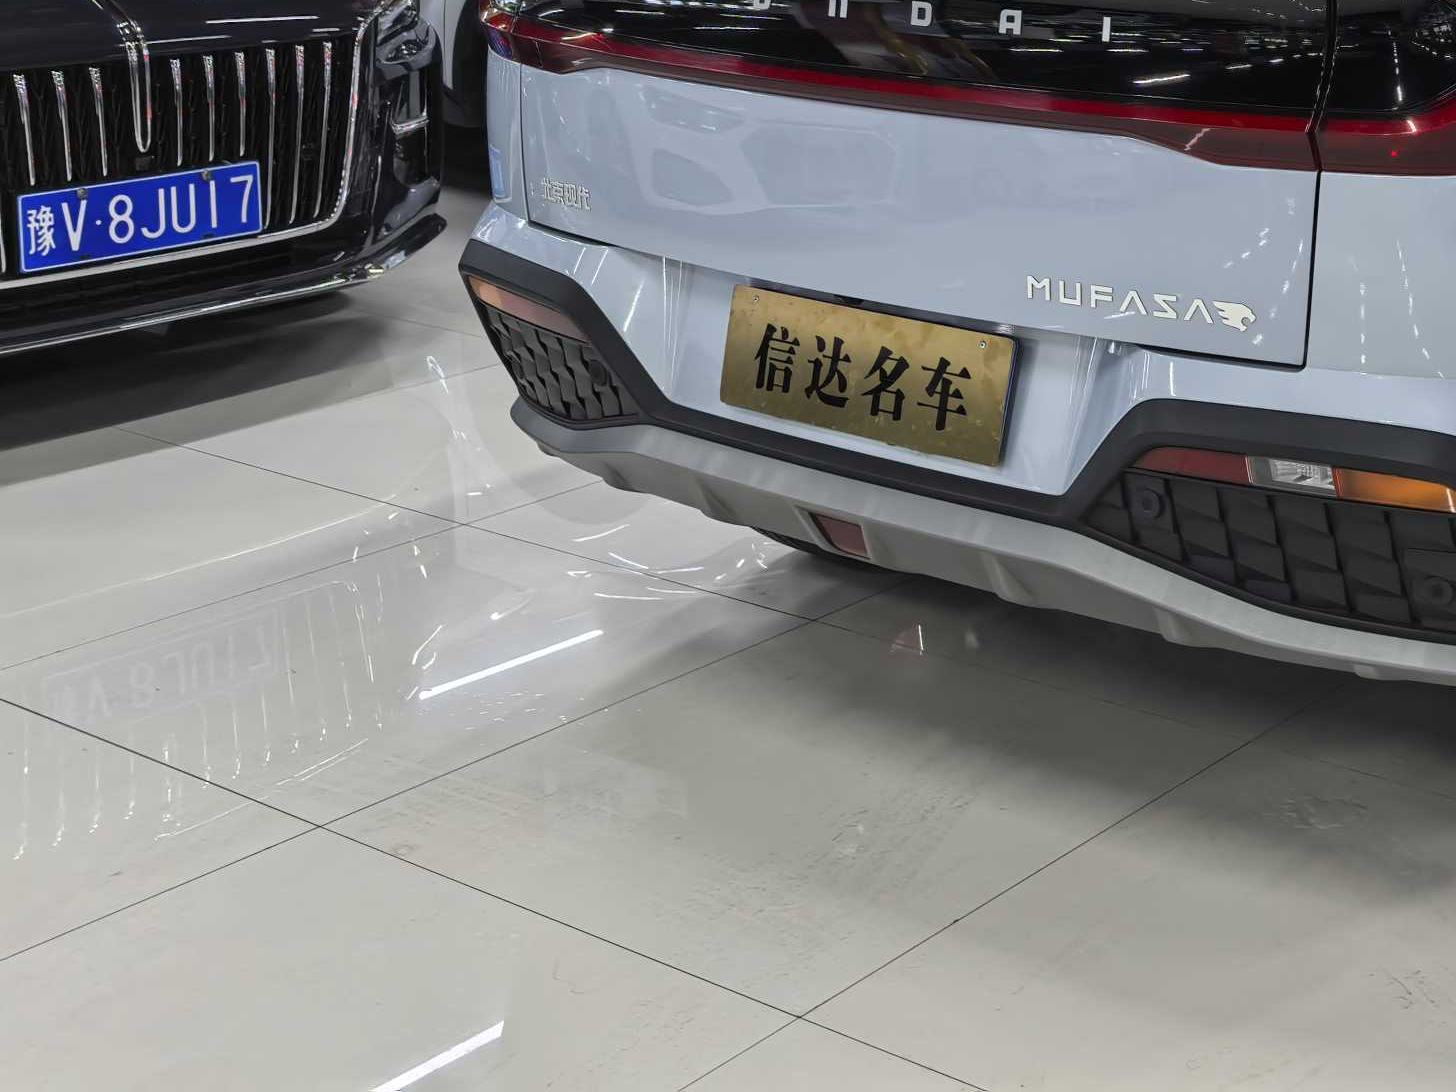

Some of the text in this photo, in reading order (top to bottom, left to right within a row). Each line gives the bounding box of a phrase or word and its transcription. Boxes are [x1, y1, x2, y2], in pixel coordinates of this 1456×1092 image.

[1026, 275, 1214, 324] MUFASA
[754, 323, 971, 431] 信达名车
